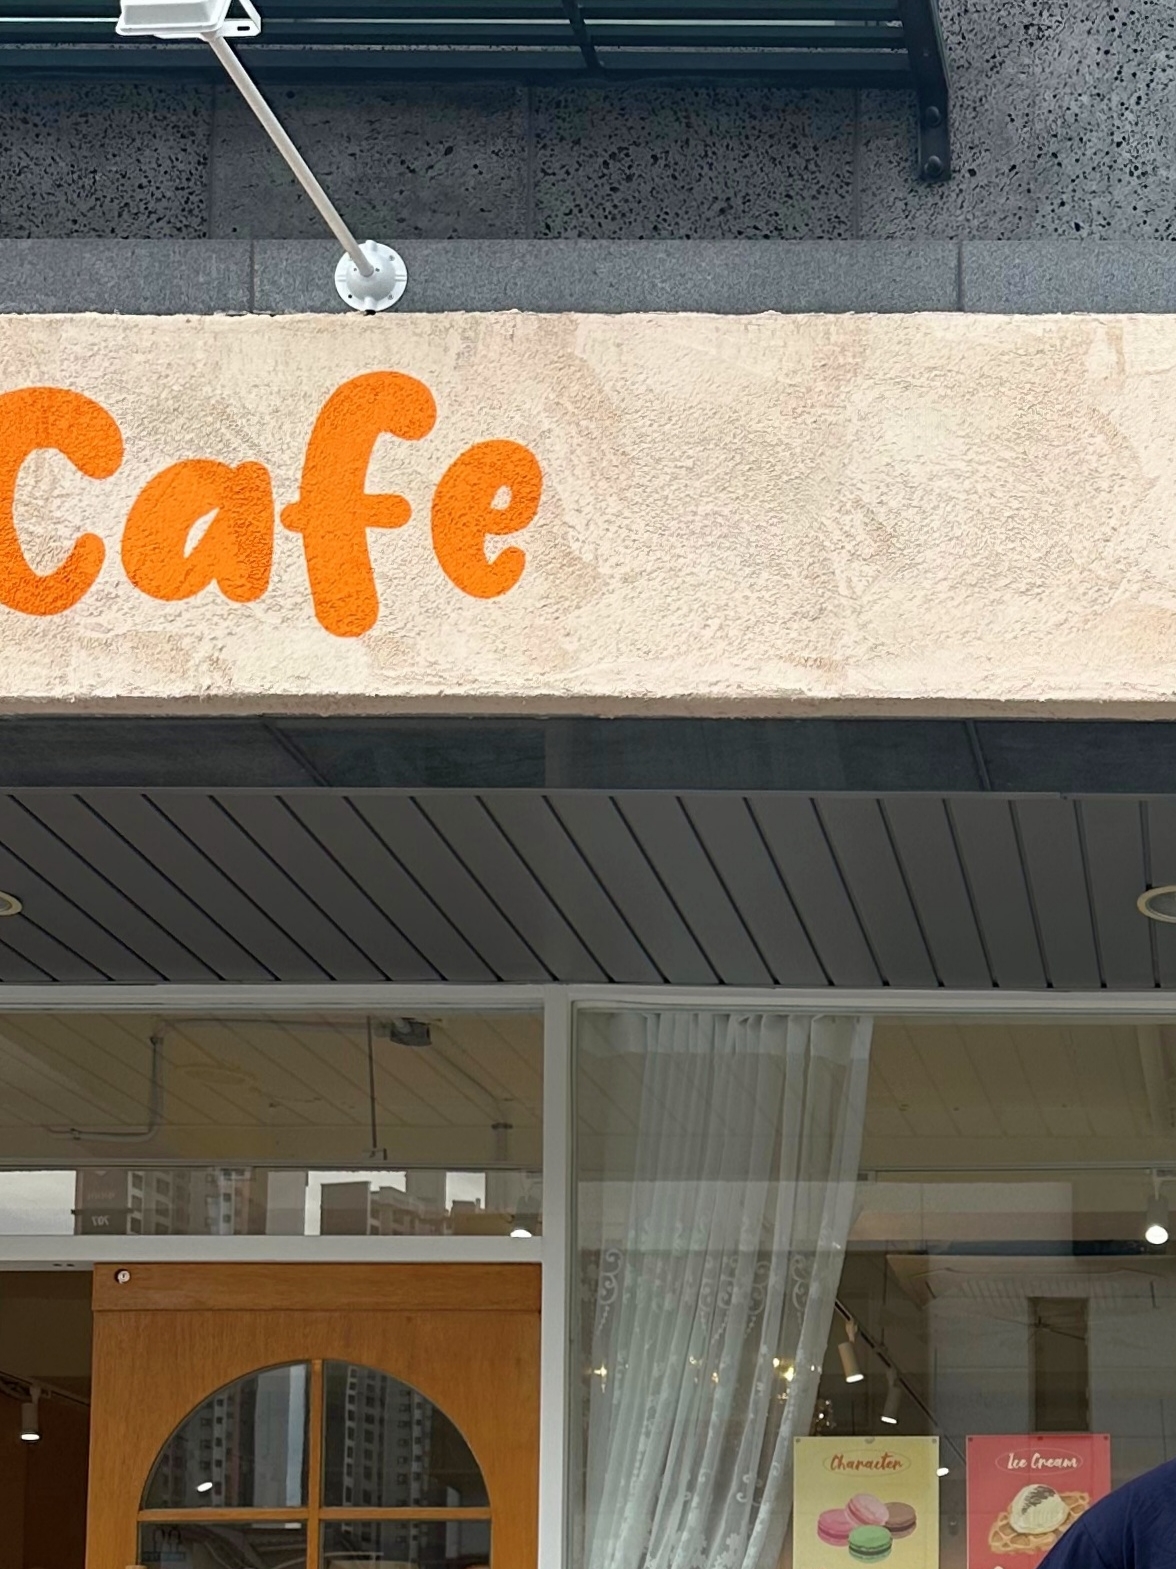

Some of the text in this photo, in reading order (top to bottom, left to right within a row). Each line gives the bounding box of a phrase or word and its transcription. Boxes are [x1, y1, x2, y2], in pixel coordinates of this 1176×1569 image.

[0, 370, 544, 638] Cafe
[830, 1452, 902, 1471] Character
[1007, 1452, 1078, 1469] Ice Cream
